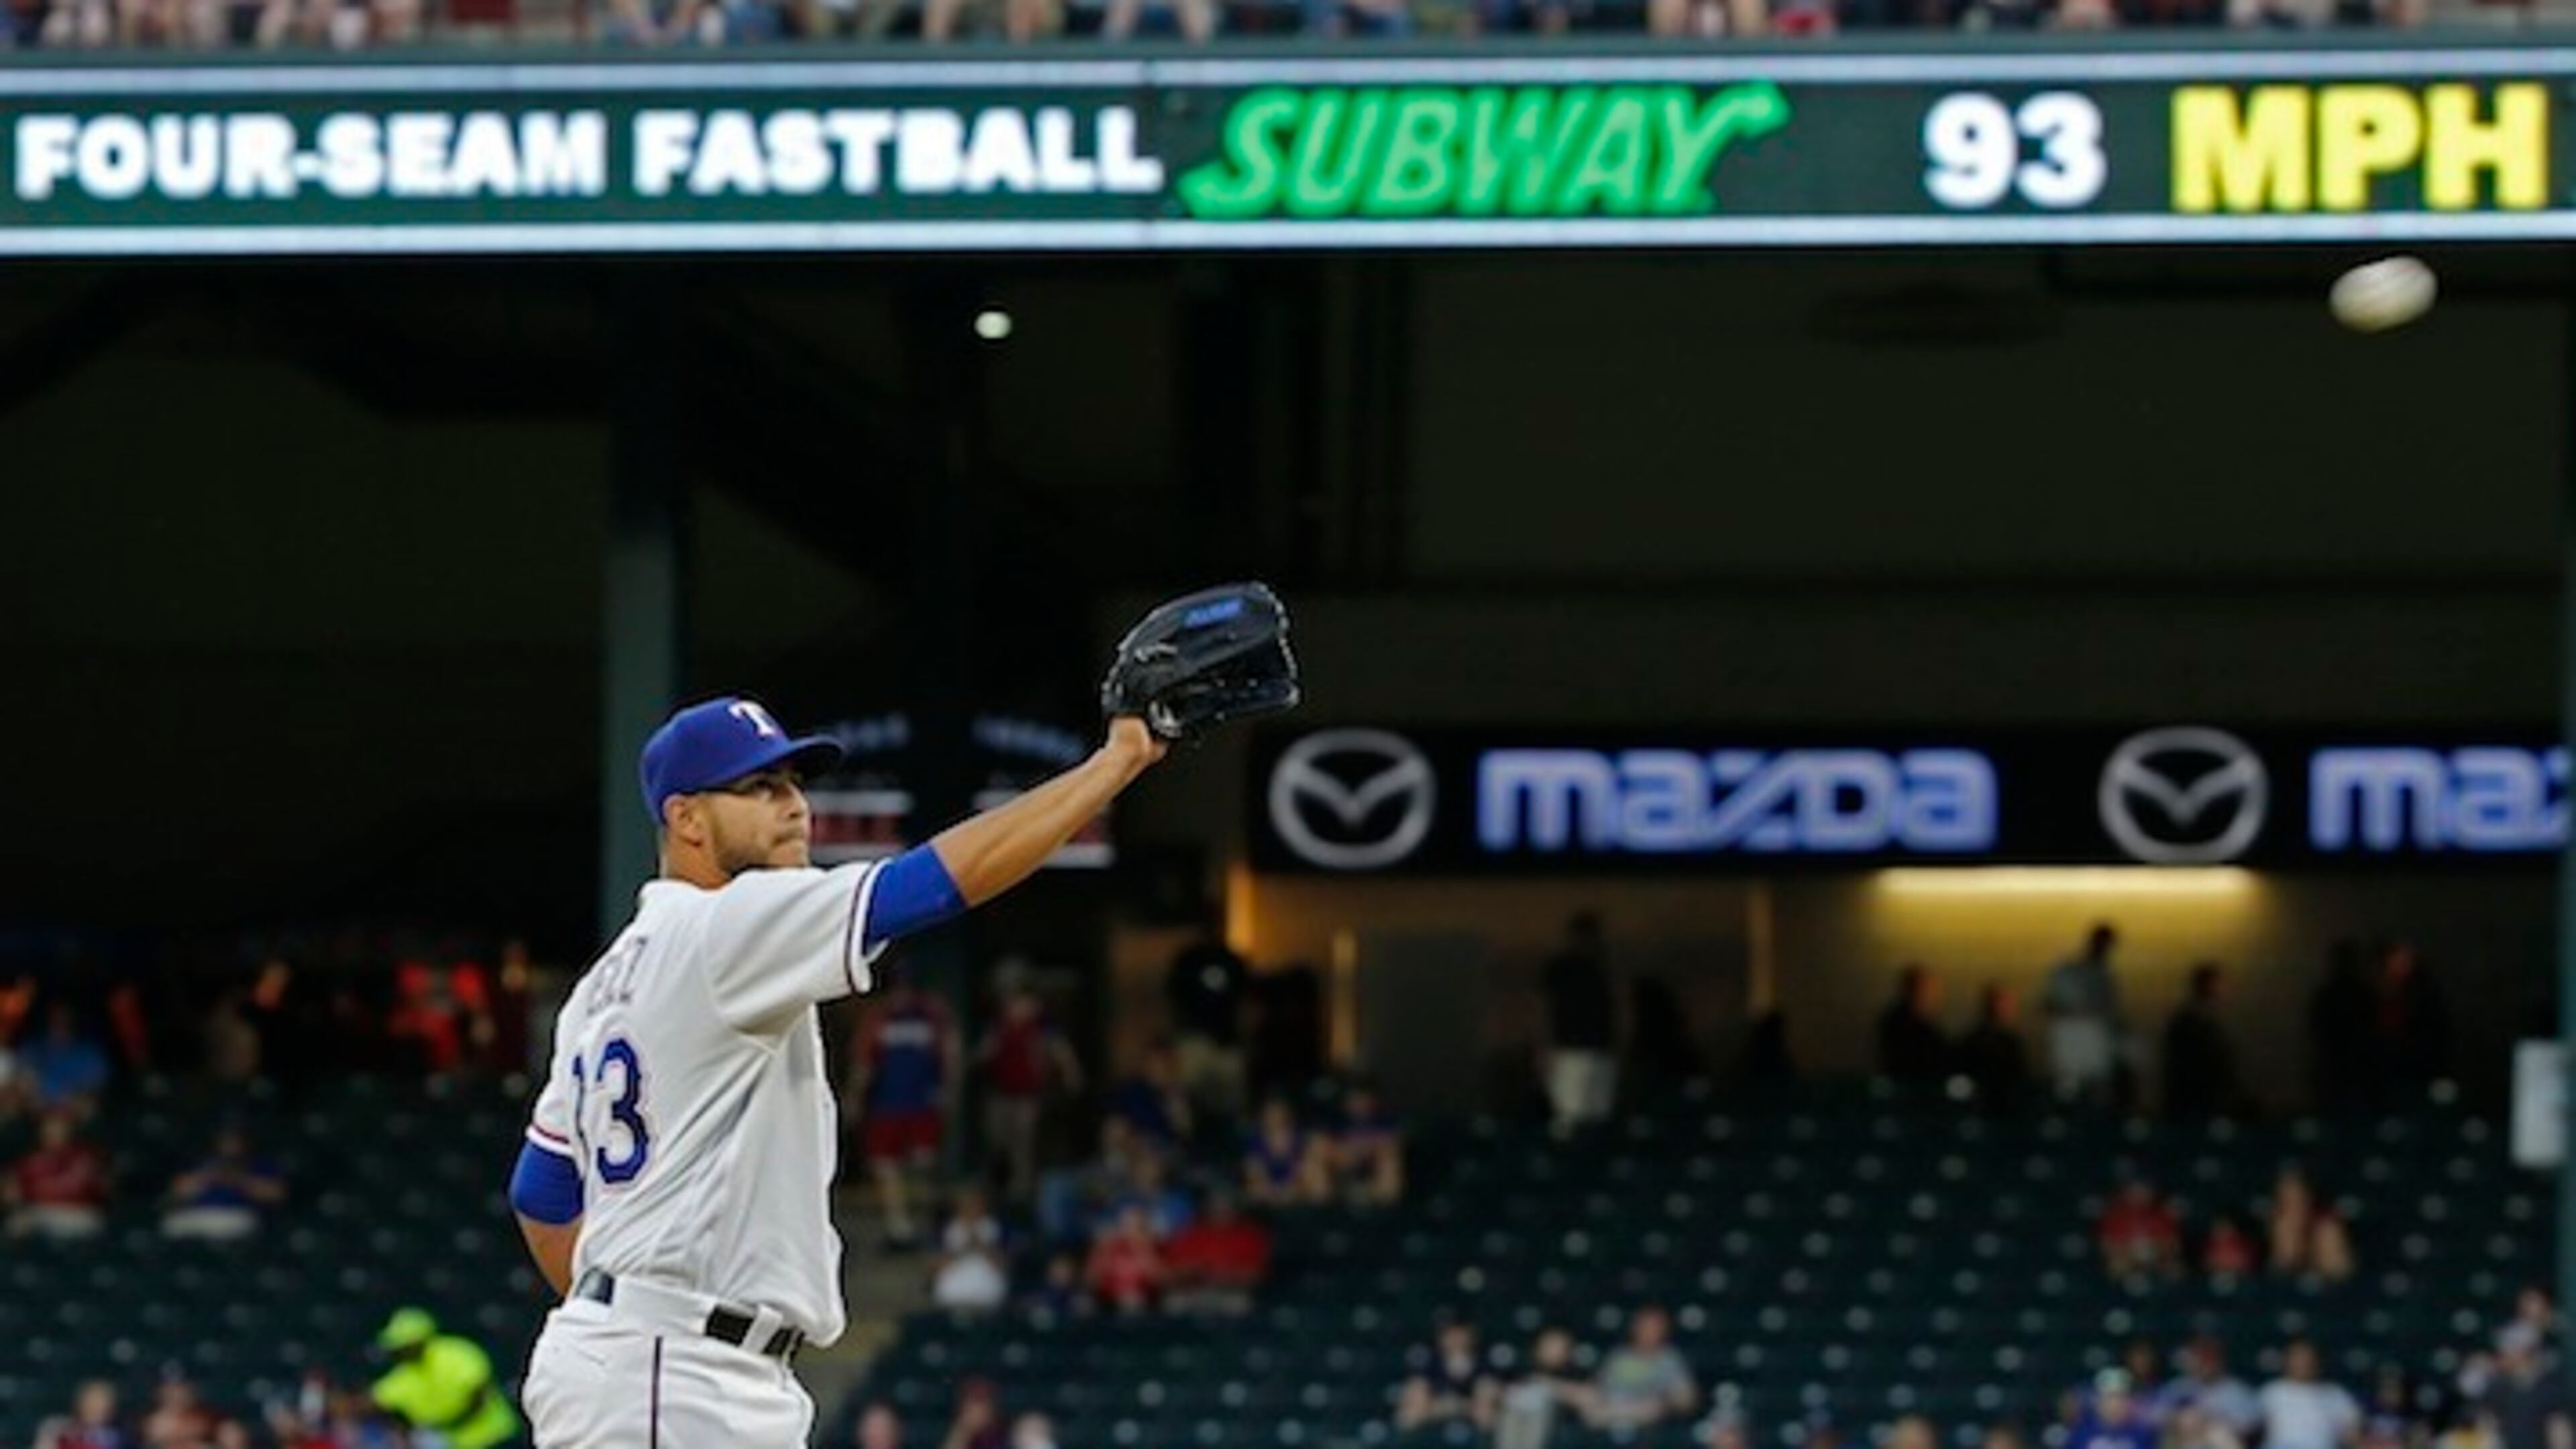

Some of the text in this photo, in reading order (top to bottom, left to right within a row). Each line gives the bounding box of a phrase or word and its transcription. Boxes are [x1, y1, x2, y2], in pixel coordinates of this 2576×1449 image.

[15, 107, 1164, 199] FOUR-SEAM FASTBALL
[1178, 80, 1790, 219] SUBWAY
[1924, 84, 2547, 212] 93 MPH
[729, 701, 778, 735] T
